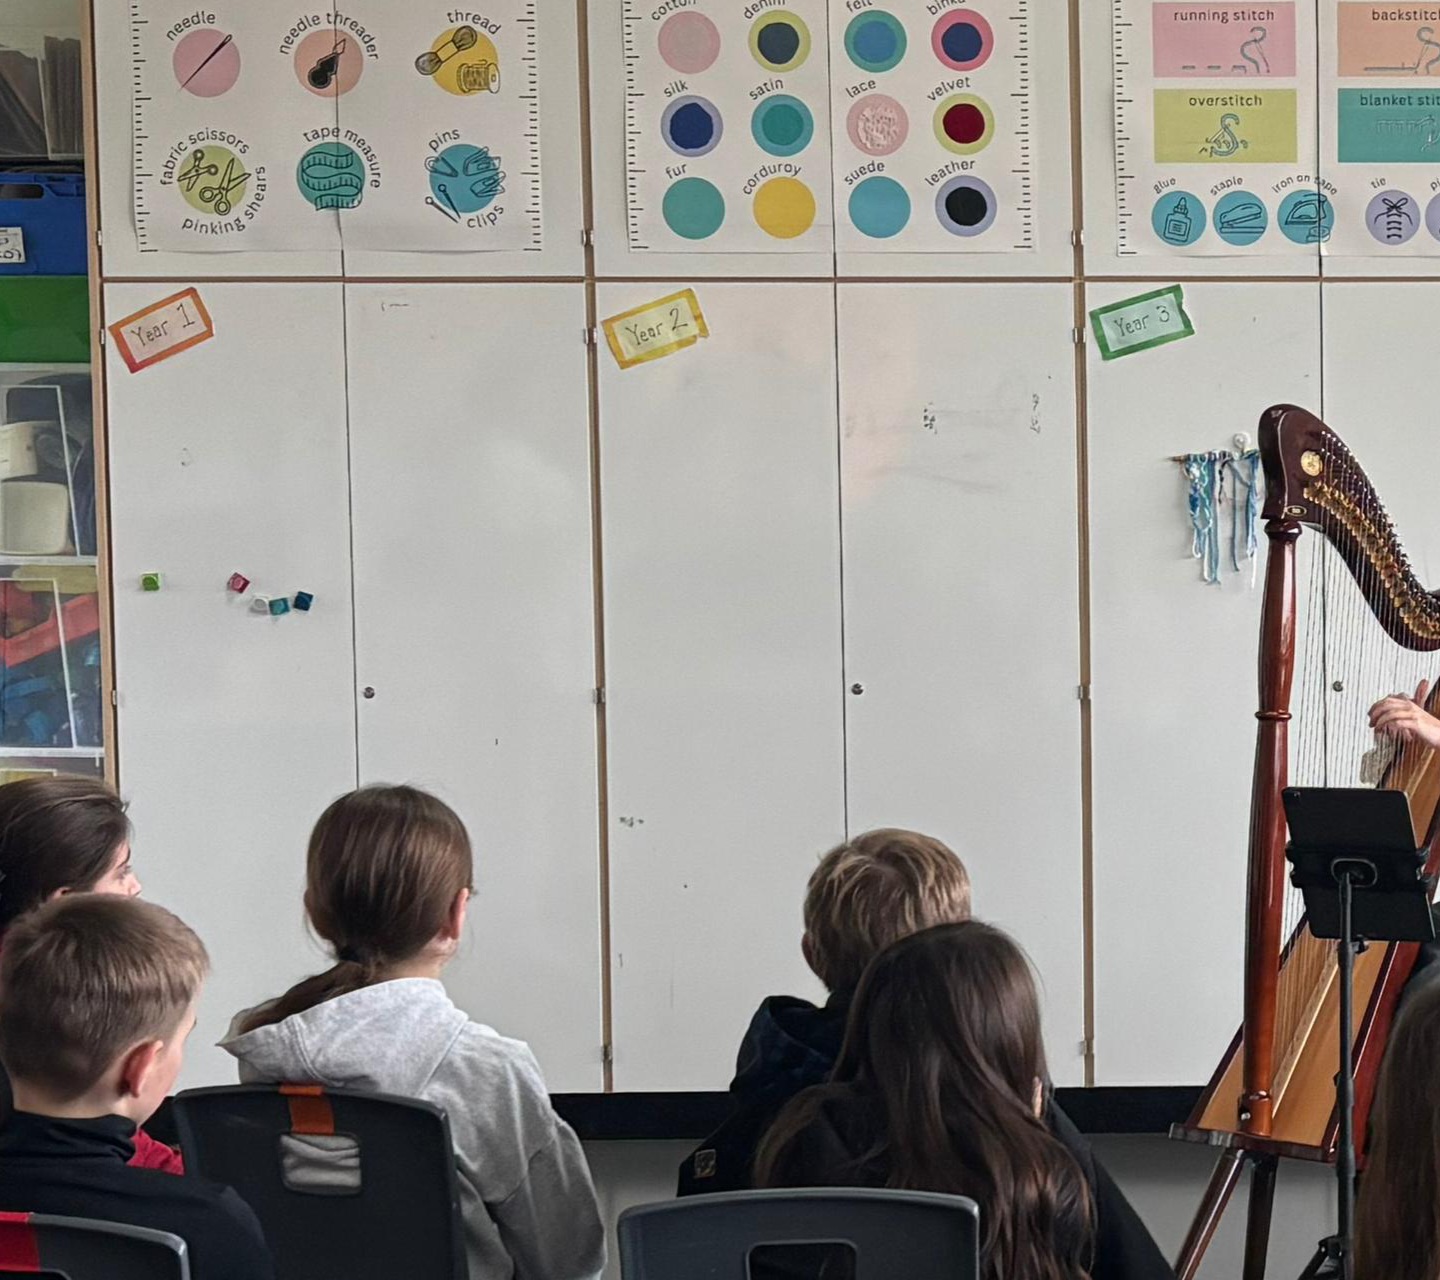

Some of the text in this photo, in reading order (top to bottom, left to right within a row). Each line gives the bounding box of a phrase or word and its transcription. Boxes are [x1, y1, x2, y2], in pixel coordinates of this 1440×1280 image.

[166, 10, 216, 41] needle
[447, 10, 501, 35] thread
[1174, 8, 1275, 23] running stitch
[279, 11, 379, 61] needle threader
[662, 80, 689, 98] silk
[749, 78, 784, 101] satin
[845, 79, 877, 99] lace
[926, 76, 972, 103] velvet
[1188, 94, 1262, 107] overstitch
[1359, 93, 1413, 106] blanket
[429, 128, 461, 152] pins
[160, 128, 250, 186] fabric scissors
[303, 126, 381, 189] tape measure
[665, 163, 688, 179] fur
[743, 163, 802, 195] corduroy
[843, 160, 886, 186] suede
[924, 158, 976, 188] leather
[1370, 176, 1387, 190] tie
[1152, 177, 1176, 195] glue
[1209, 175, 1243, 196] staple
[1271, 175, 1294, 194] iron
[1297, 174, 1311, 184] on
[181, 166, 266, 235] pinking shears
[465, 204, 505, 229] clips
[131, 304, 196, 347] Year 1
[625, 308, 689, 347] Year 2
[1113, 305, 1170, 338] Year 3
